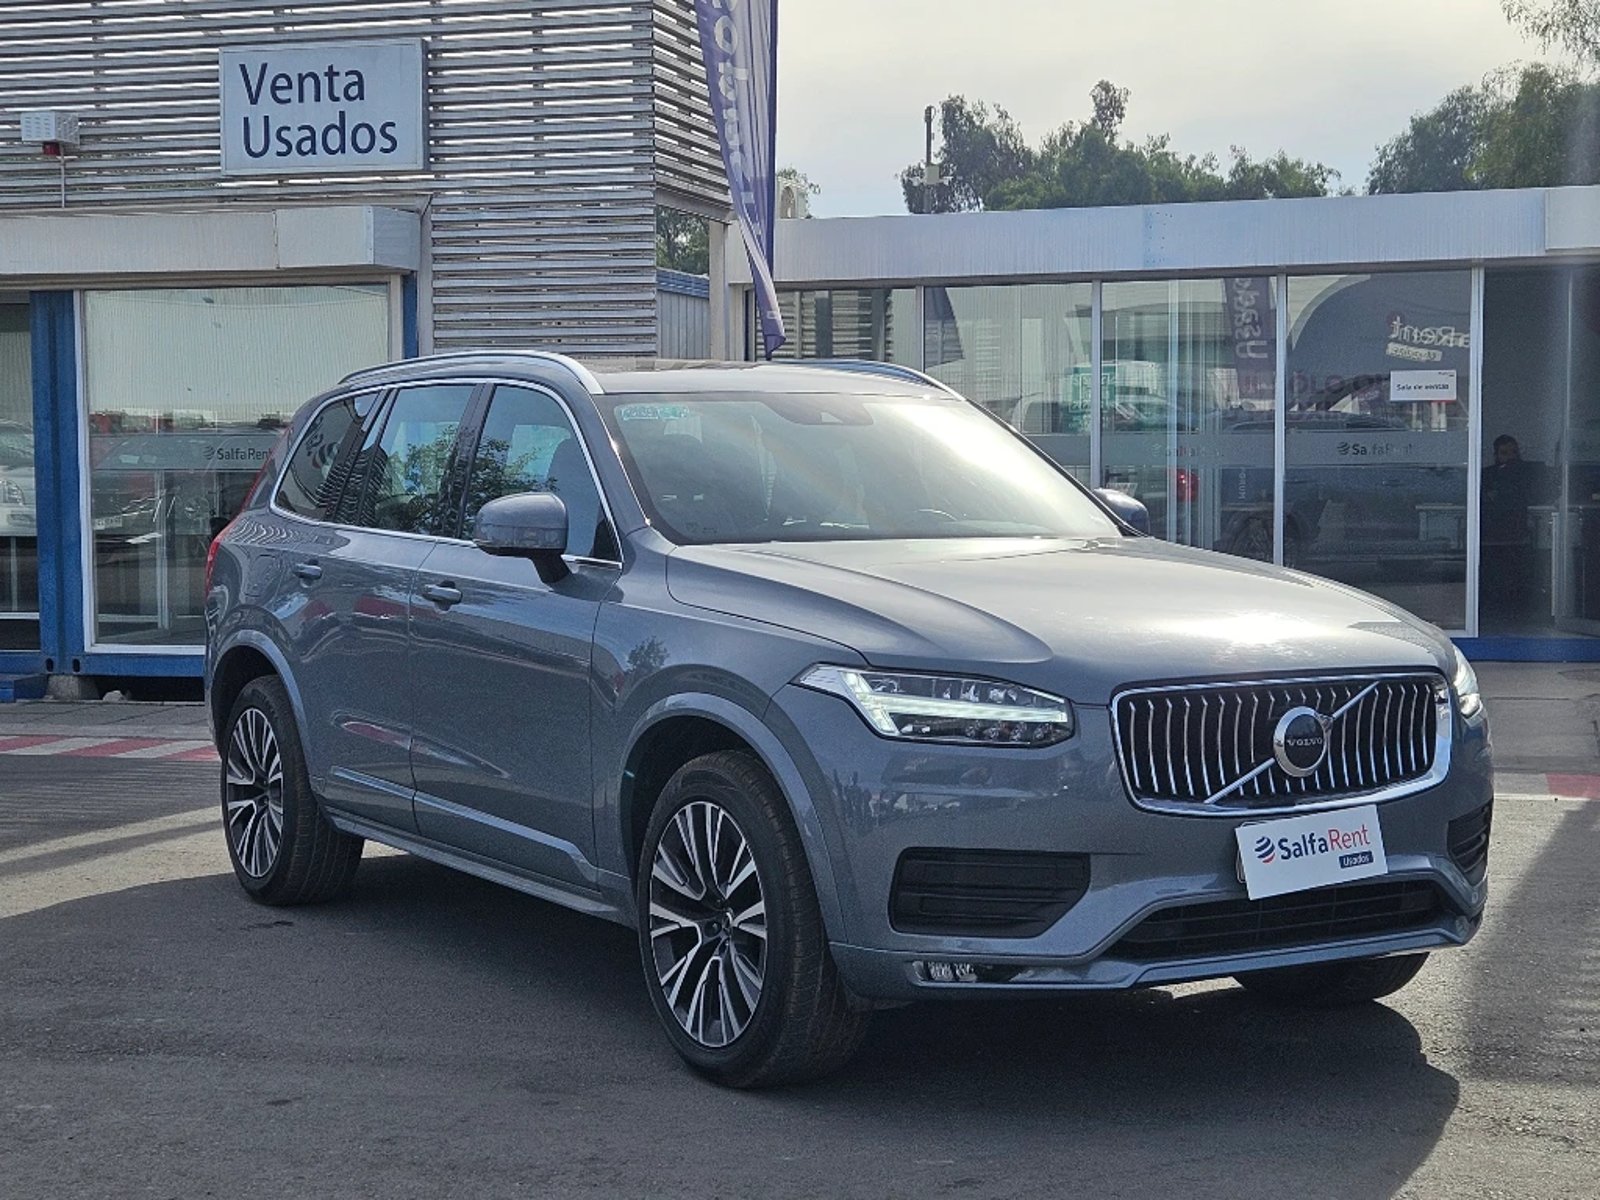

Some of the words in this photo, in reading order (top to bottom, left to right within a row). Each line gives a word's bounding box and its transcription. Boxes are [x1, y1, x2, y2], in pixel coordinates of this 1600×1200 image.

[239, 62, 365, 105] Venta
[243, 111, 398, 158] Usados
[1396, 383, 1411, 391] Sala
[1287, 737, 1322, 746] VOLVO
[1278, 824, 1371, 860] SalfaRent
[1343, 853, 1370, 867] Usados
